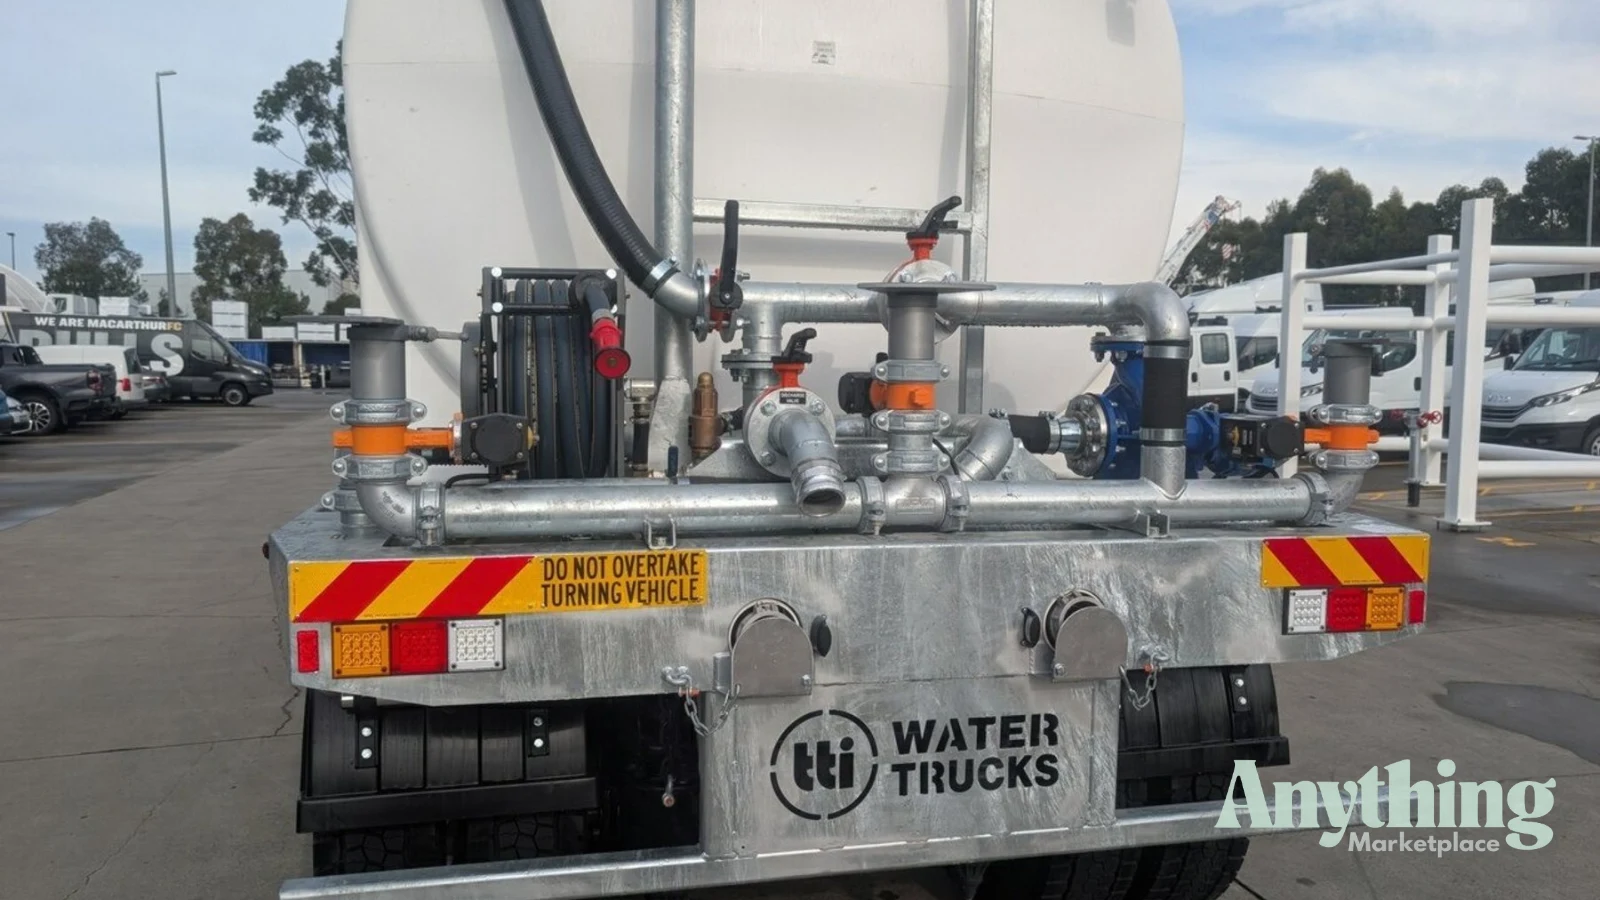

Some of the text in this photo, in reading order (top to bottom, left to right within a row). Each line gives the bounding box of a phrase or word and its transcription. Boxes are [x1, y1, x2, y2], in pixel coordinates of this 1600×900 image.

[34, 316, 56, 326] WE
[59, 317, 85, 328] ARE
[543, 552, 700, 581] DO NOT OVERTAKE
[541, 578, 699, 607] TURNING VEHICLE
[891, 713, 1060, 755] WATER
[793, 736, 855, 792] tti
[891, 754, 1060, 796] TRUCKS
